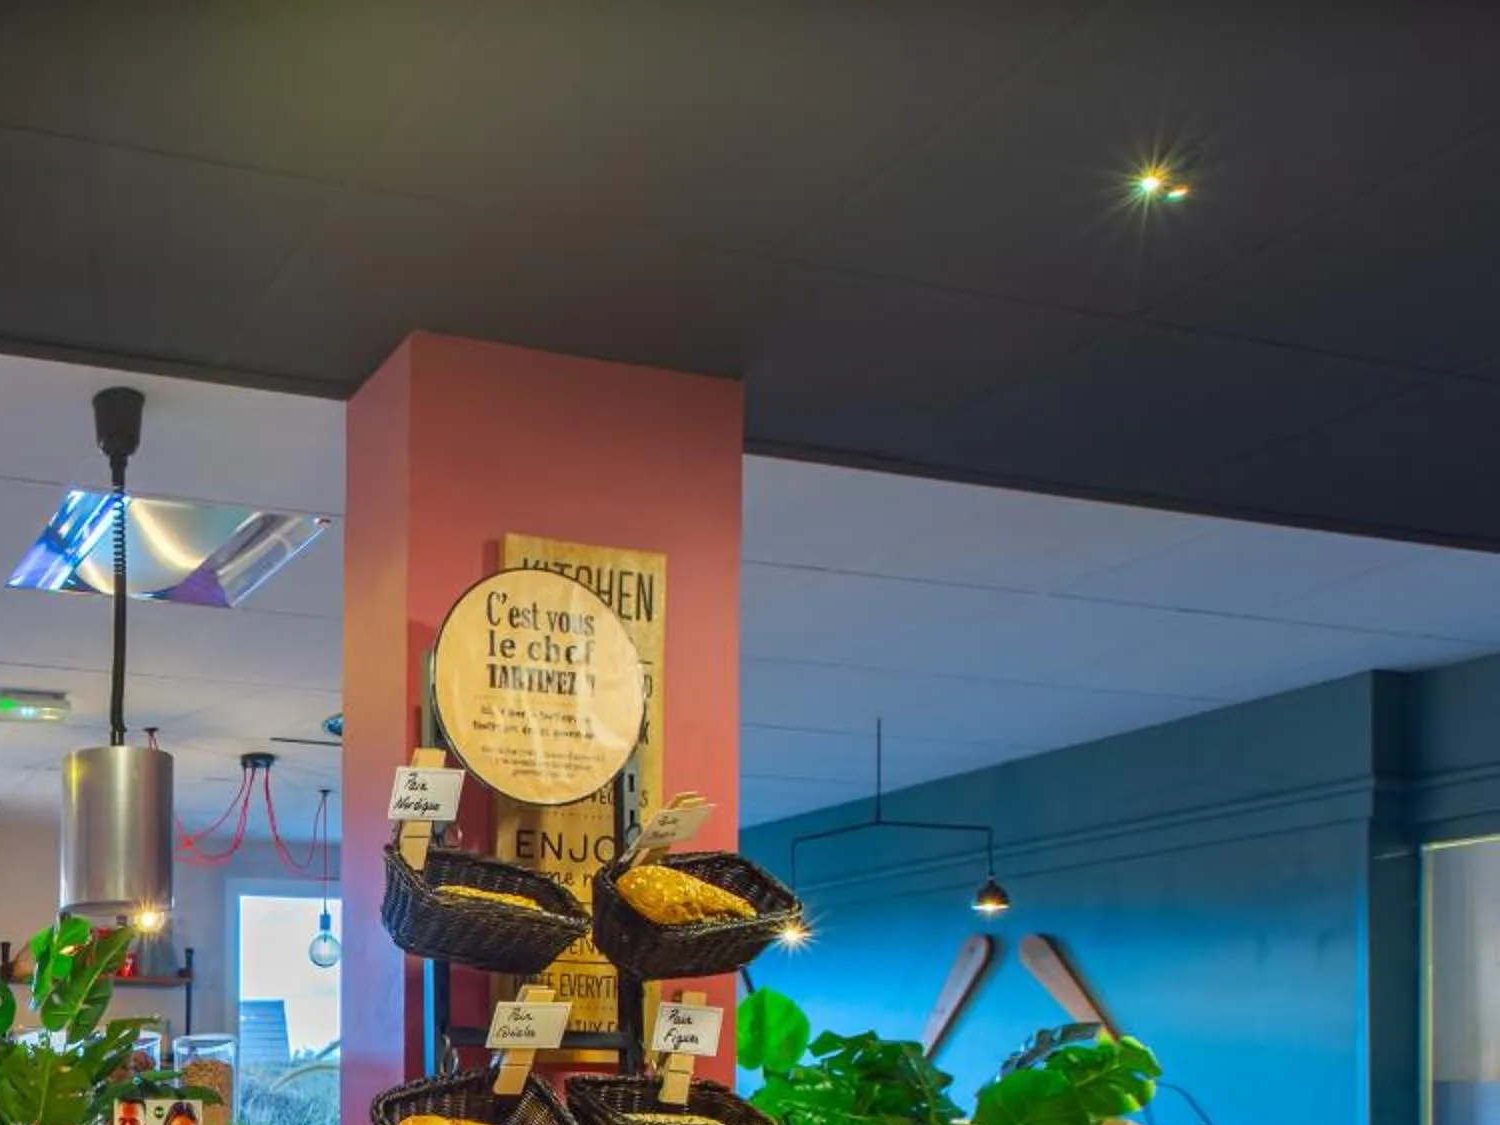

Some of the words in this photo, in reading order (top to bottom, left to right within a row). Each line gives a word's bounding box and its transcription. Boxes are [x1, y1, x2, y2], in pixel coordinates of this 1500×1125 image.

[486, 591, 541, 631] C'est
[547, 610, 595, 637] vous
[488, 629, 516, 659] le
[527, 635, 595, 665] chef
